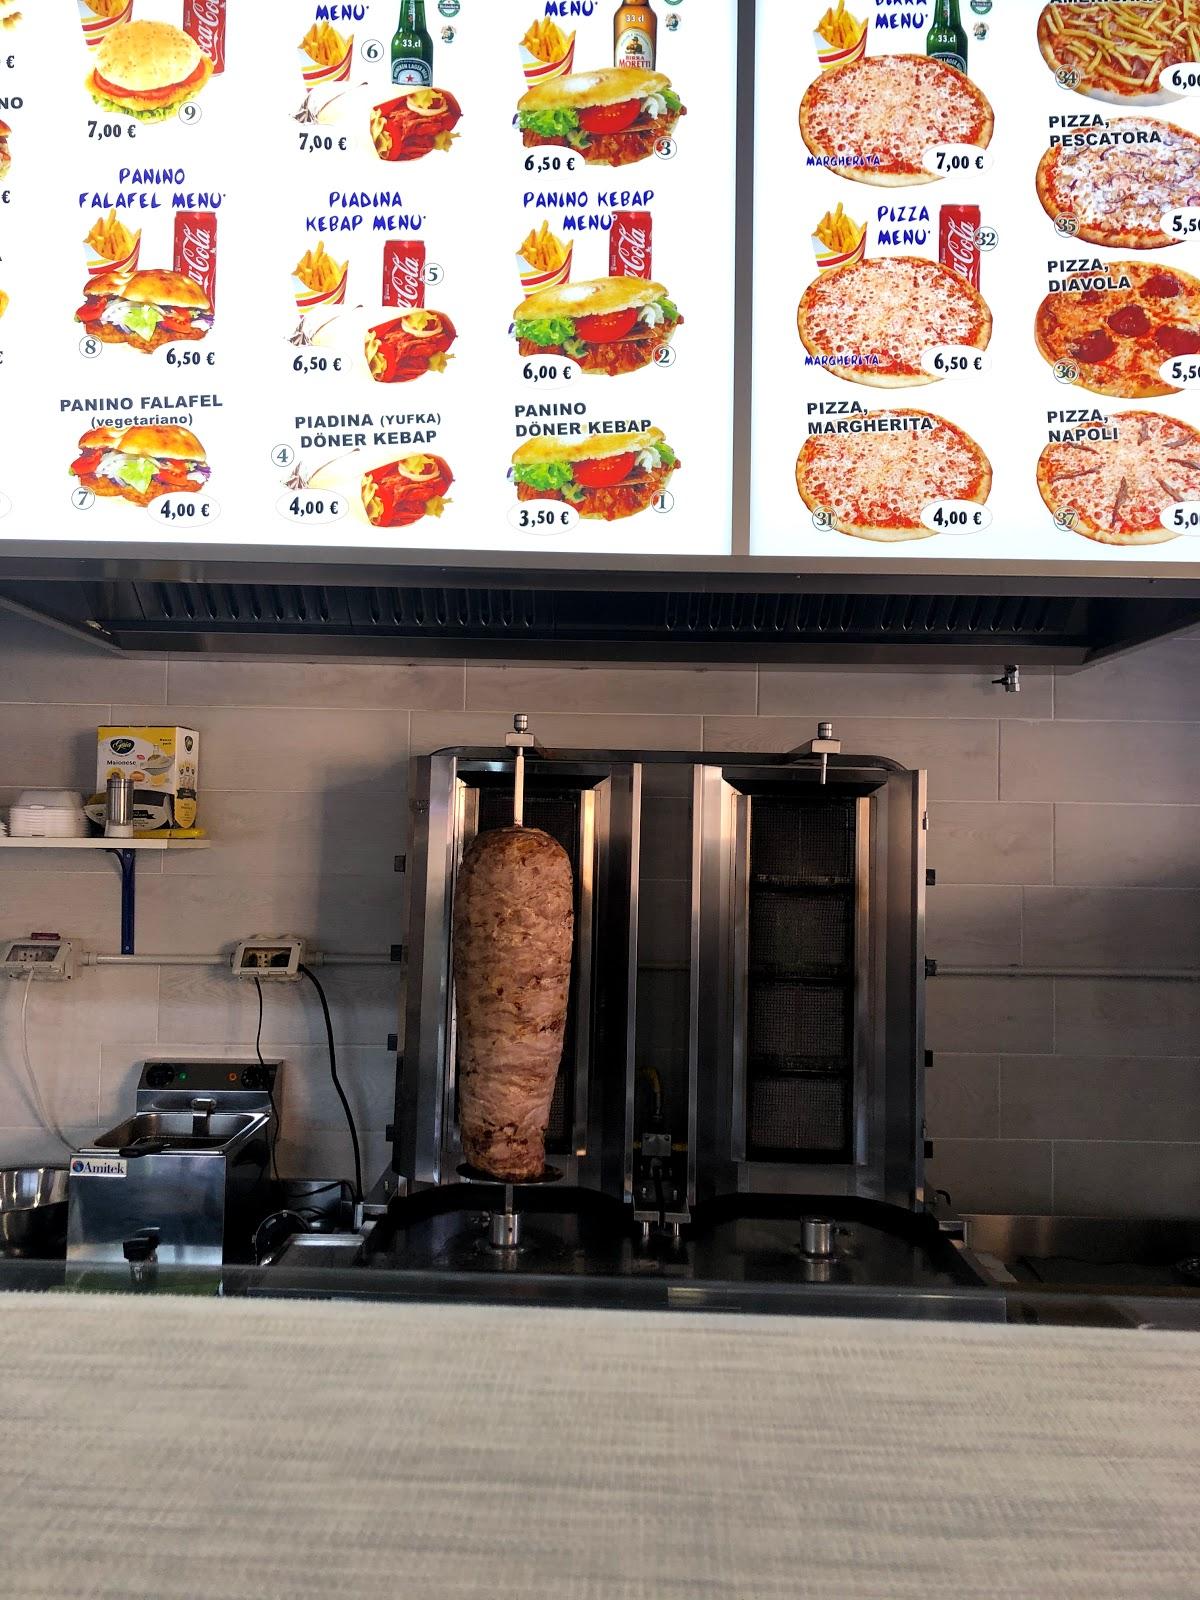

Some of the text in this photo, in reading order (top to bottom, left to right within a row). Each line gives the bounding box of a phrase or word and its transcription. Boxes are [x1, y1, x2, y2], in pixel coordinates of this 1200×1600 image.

[367, 44, 378, 58] 6
[1058, 71, 1076, 84] 34
[1172, 70, 1200, 89] 6,0
[184, 106, 196, 120] 9
[1049, 114, 1110, 128] PIZZA,
[88, 120, 135, 140] 7,00 €
[299, 133, 346, 152] 7,00 €
[1050, 131, 1162, 147] PESCATORA
[660, 141, 670, 155] 3
[525, 155, 574, 173] 6,50 €
[806, 156, 880, 167] MARGHERITA
[937, 152, 983, 172] 7,00 €
[120, 168, 185, 184] PANINO
[79, 193, 161, 208] FALAFEL
[330, 192, 402, 207] PIADINA
[524, 190, 654, 208] PANINO KEBAP
[878, 206, 929, 222] PIZZA
[307, 215, 362, 231] KEBAP
[1057, 218, 1076, 232] 35
[976, 232, 996, 246] 32
[1048, 258, 1109, 273] PIZZA,
[428, 267, 438, 282] 5
[1049, 276, 1131, 292] DIAVOLA
[85, 340, 96, 354] 8
[167, 348, 214, 367] 6,50 €
[659, 349, 670, 363] 2
[805, 354, 879, 366] MARGHERITA
[934, 353, 982, 372] 6,50 €
[293, 355, 341, 374] 6,50 €
[1057, 365, 1076, 379] 36
[523, 363, 571, 382] 6,00 €
[61, 395, 222, 411] PANINO FALAFEL
[515, 403, 586, 417] PANINO
[807, 401, 868, 415] PIZZA,
[90, 414, 193, 429] (vegetariano)
[296, 413, 440, 428] PIADINA (YUFKA)
[1047, 409, 1109, 424] PIZZA,
[516, 419, 651, 437] DÖNER KEBAP
[808, 417, 933, 434] MARGHERITA
[301, 431, 436, 450] DÖNER KEBAP
[1049, 428, 1118, 442] NAPOLI
[276, 450, 288, 462] 4
[78, 491, 89, 505] 7
[659, 495, 666, 509] 1
[161, 500, 209, 520] 4,00 €
[290, 497, 338, 516] 4,00 €
[520, 510, 568, 527] 3,50 €
[816, 512, 833, 525] 31
[933, 508, 981, 527] 4,00 €
[1057, 513, 1075, 527] 37
[1174, 509, 1198, 529] 5,0
[84, 1162, 124, 1174] Amitek
